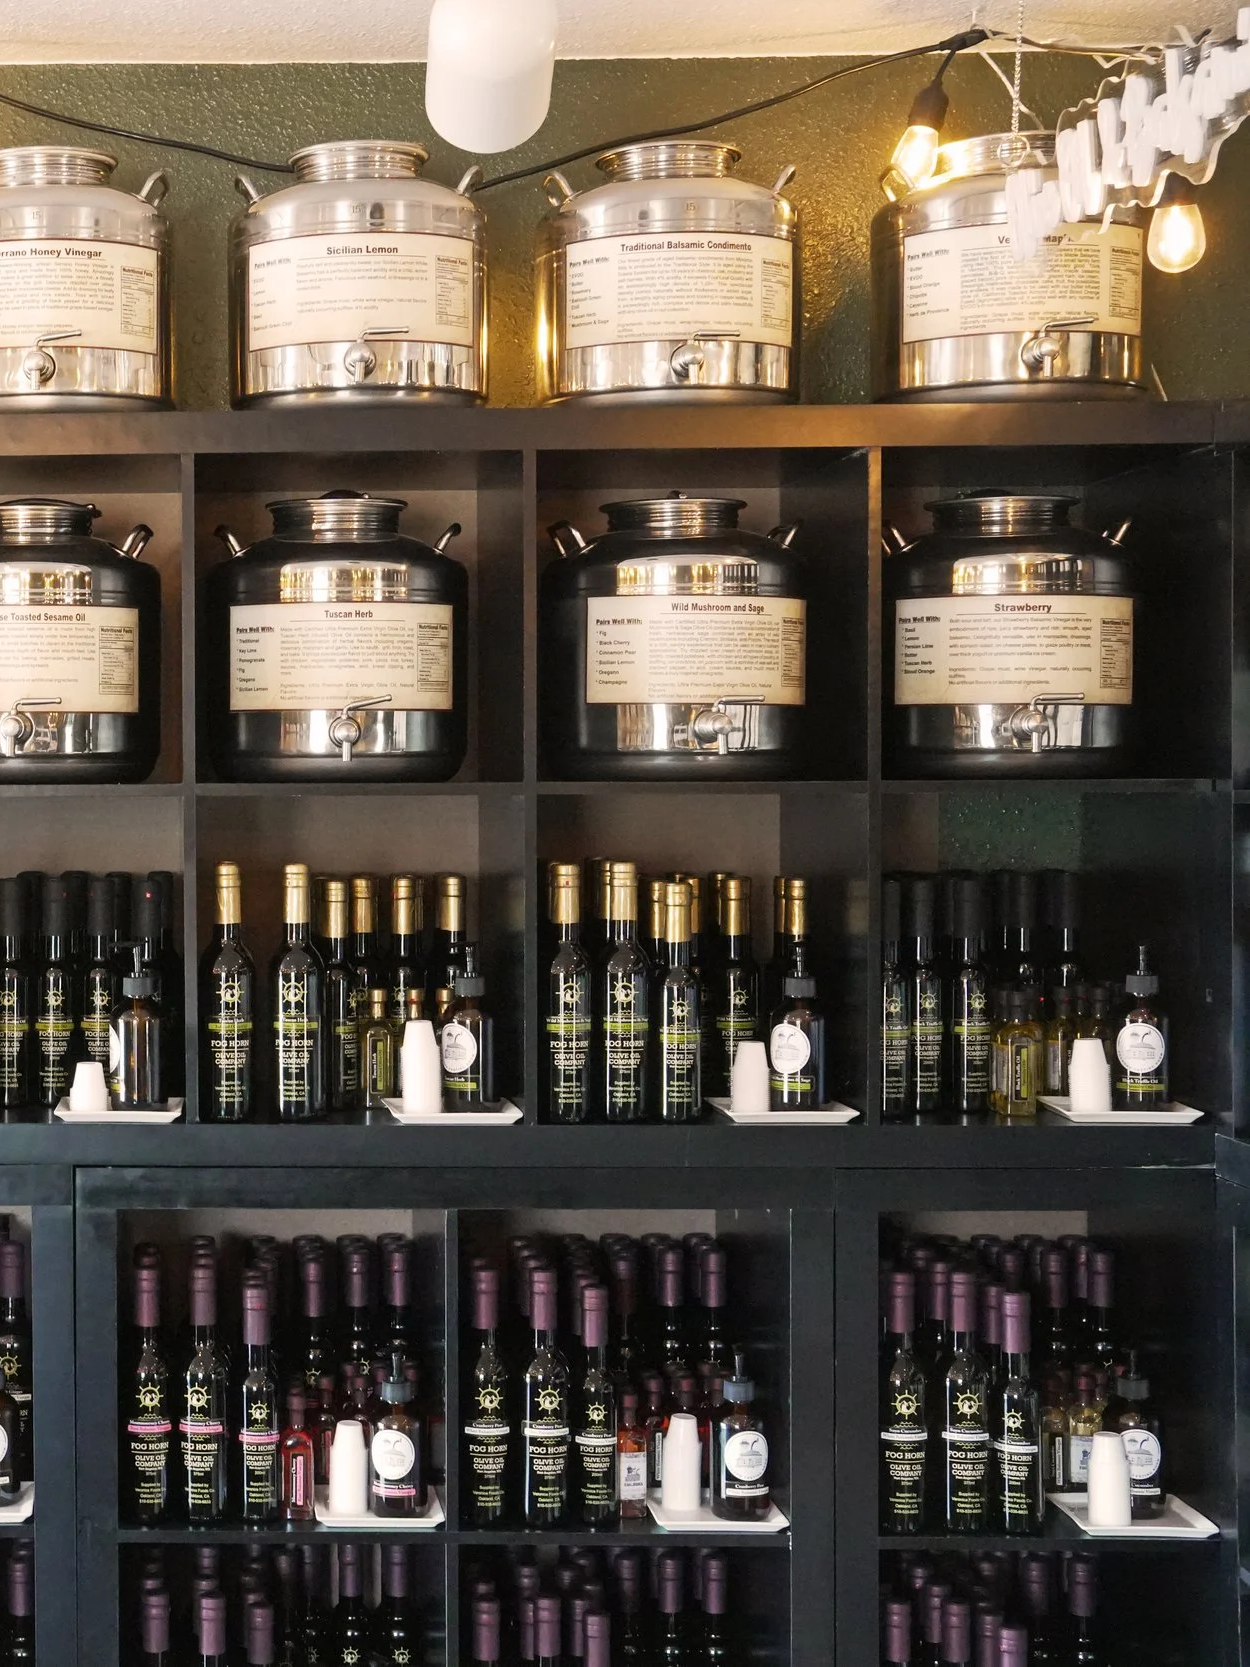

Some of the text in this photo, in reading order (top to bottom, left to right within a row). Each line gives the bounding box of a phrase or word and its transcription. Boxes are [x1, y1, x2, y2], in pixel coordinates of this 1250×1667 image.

[327, 245, 398, 255] Sicilian Lemon
[621, 241, 751, 252] Traditional Balsamic Condimento
[30, 248, 61, 258] Honey
[65, 248, 102, 259] Vinegar
[671, 603, 765, 614] Wild Mushroom and Sage
[994, 603, 1052, 613] Strawberry
[11, 613, 41, 621] Toasted
[44, 613, 73, 621] Sesame
[76, 613, 86, 621] Oil
[324, 610, 373, 618] Tuscan Herb
[131, 1441, 169, 1450] FOG HORN
[469, 1444, 507, 1452] FOG HORN
[885, 1451, 925, 1459] FOG HORN
